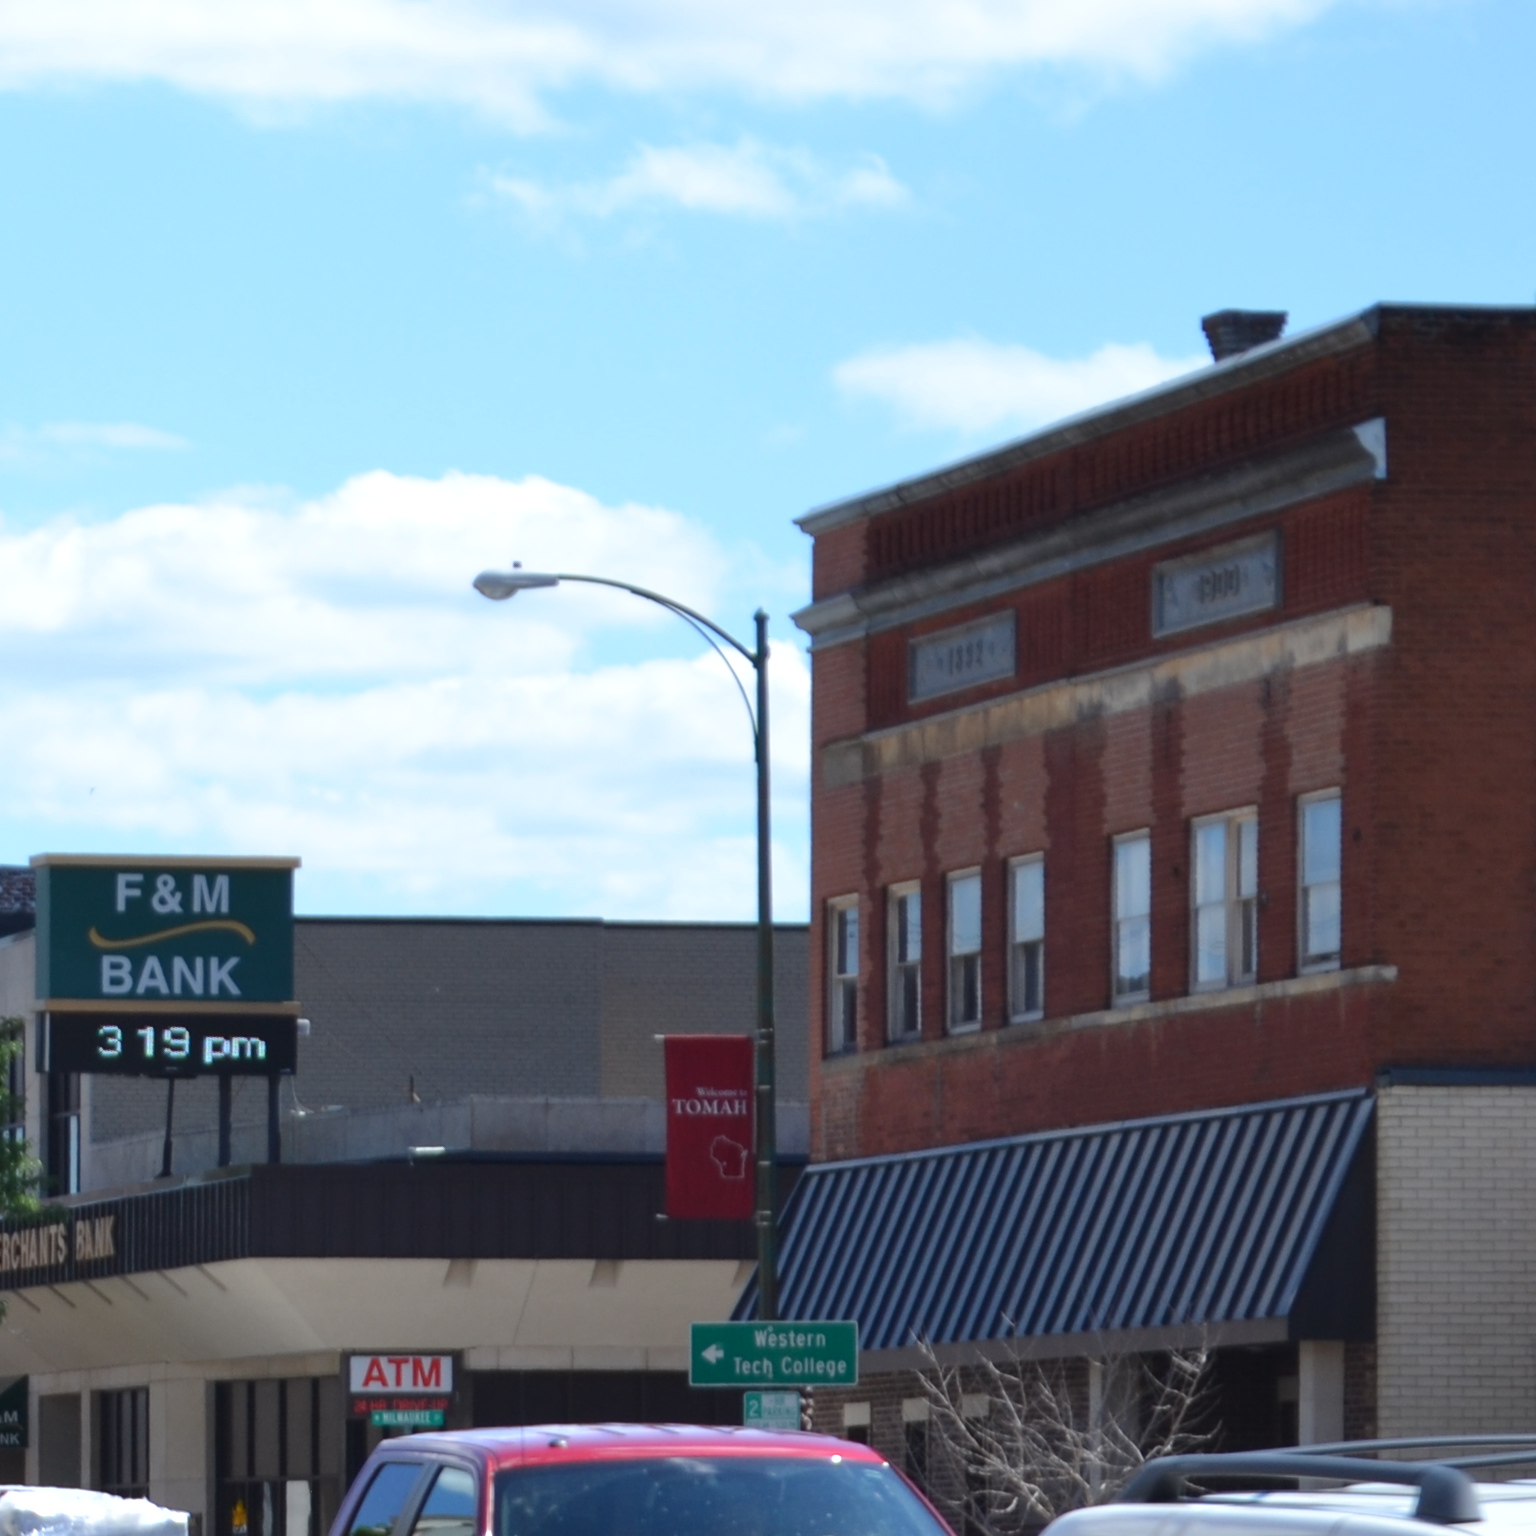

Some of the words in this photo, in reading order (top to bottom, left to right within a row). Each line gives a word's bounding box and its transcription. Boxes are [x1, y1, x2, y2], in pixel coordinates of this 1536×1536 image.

[101, 955, 242, 995] BANK
[204, 1036, 266, 1064] pm
[672, 1098, 747, 1115] TOMAH
[75, 1215, 115, 1261] BANK
[755, 1330, 826, 1347] Western
[362, 1357, 441, 1387] ATM
[734, 1357, 773, 1374] Tech
[782, 1357, 847, 1377] College
[749, 1400, 759, 1417] 2
